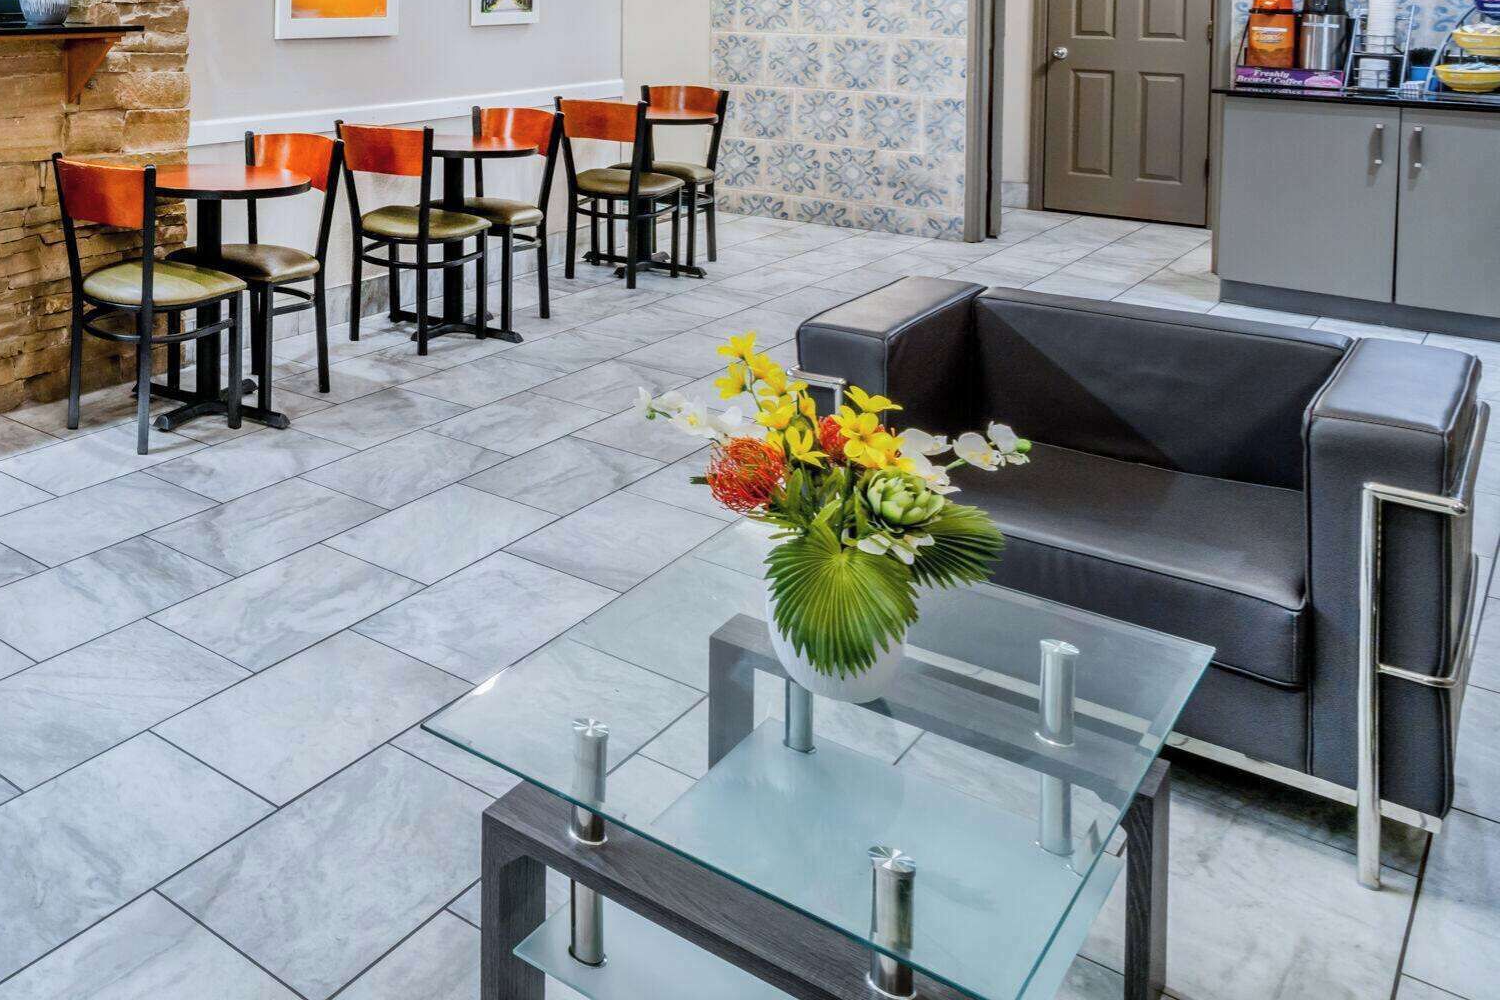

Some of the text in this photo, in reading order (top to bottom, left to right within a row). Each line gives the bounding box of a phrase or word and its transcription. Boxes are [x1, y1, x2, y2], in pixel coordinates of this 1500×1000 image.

[1252, 69, 1290, 78] Freshly
[1237, 75, 1303, 86] Brewed Coffee
